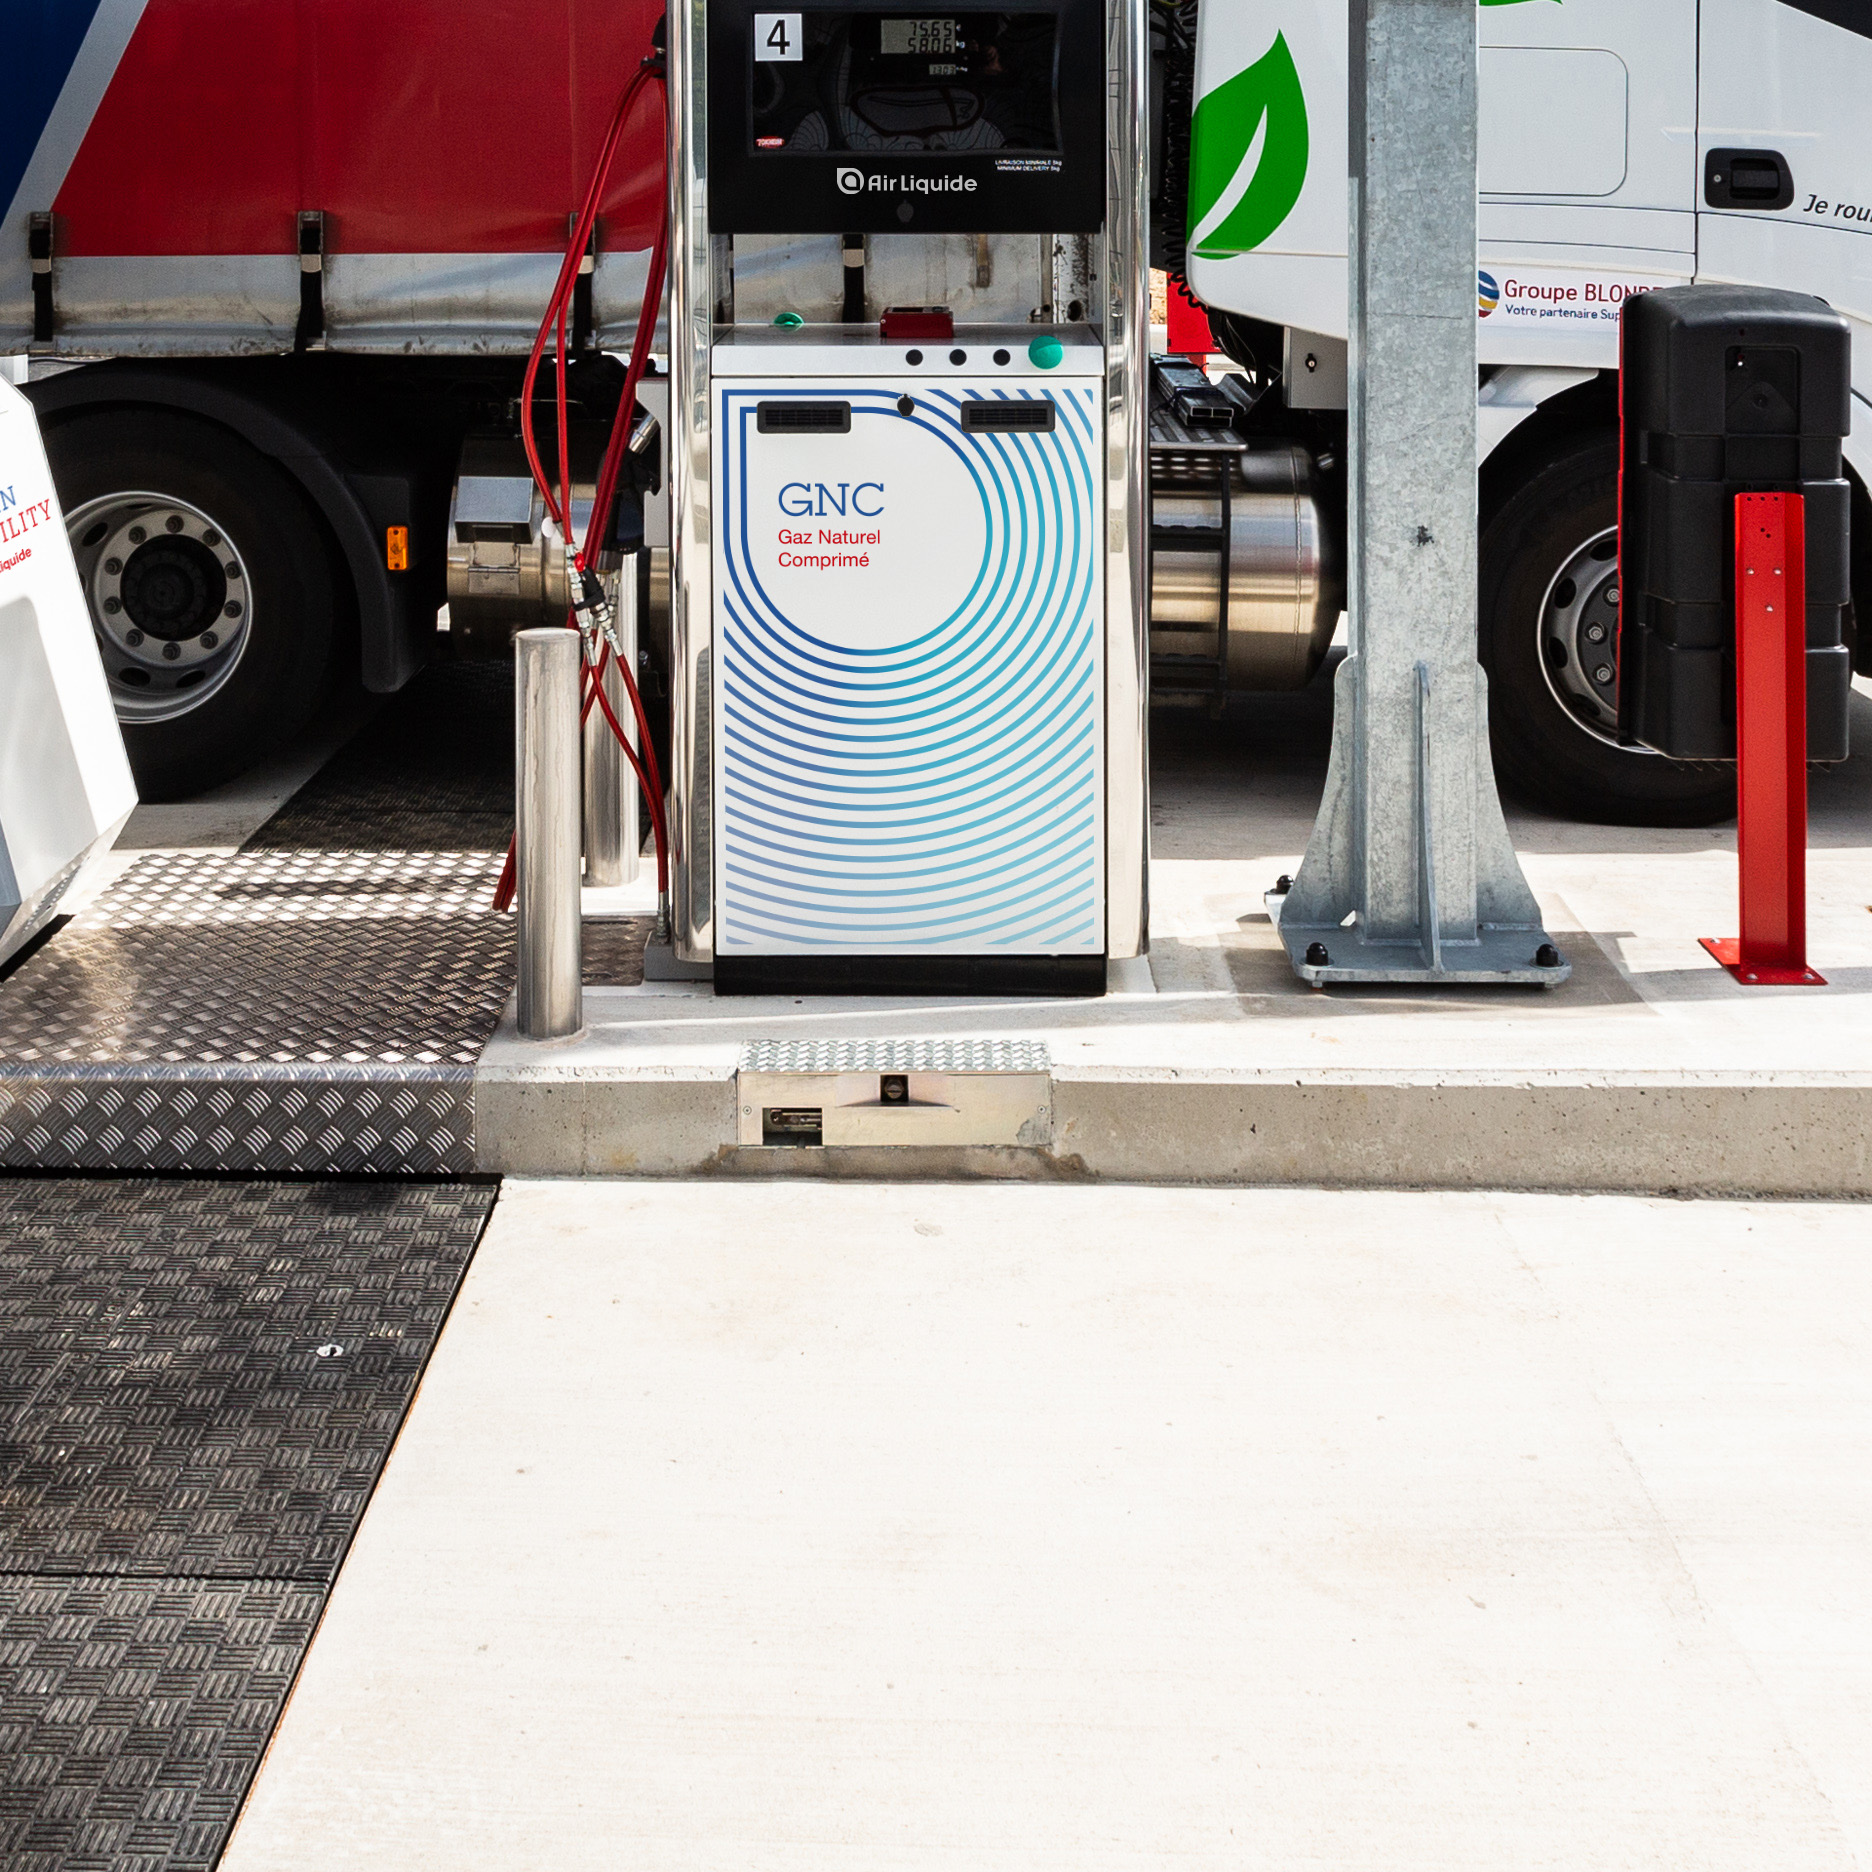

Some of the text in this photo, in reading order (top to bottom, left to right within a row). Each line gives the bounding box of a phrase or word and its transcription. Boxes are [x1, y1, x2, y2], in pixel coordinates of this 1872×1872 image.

[766, 19, 791, 56] 4
[868, 174, 977, 195] Air Liquide
[1803, 194, 1828, 214] Je
[1505, 279, 1578, 304] Groupe
[1505, 304, 1537, 316] Votre
[1540, 306, 1598, 320] partenaire
[778, 482, 885, 517] GNC
[778, 529, 880, 545] Gaz Naturel
[778, 552, 870, 571] Comprimé
